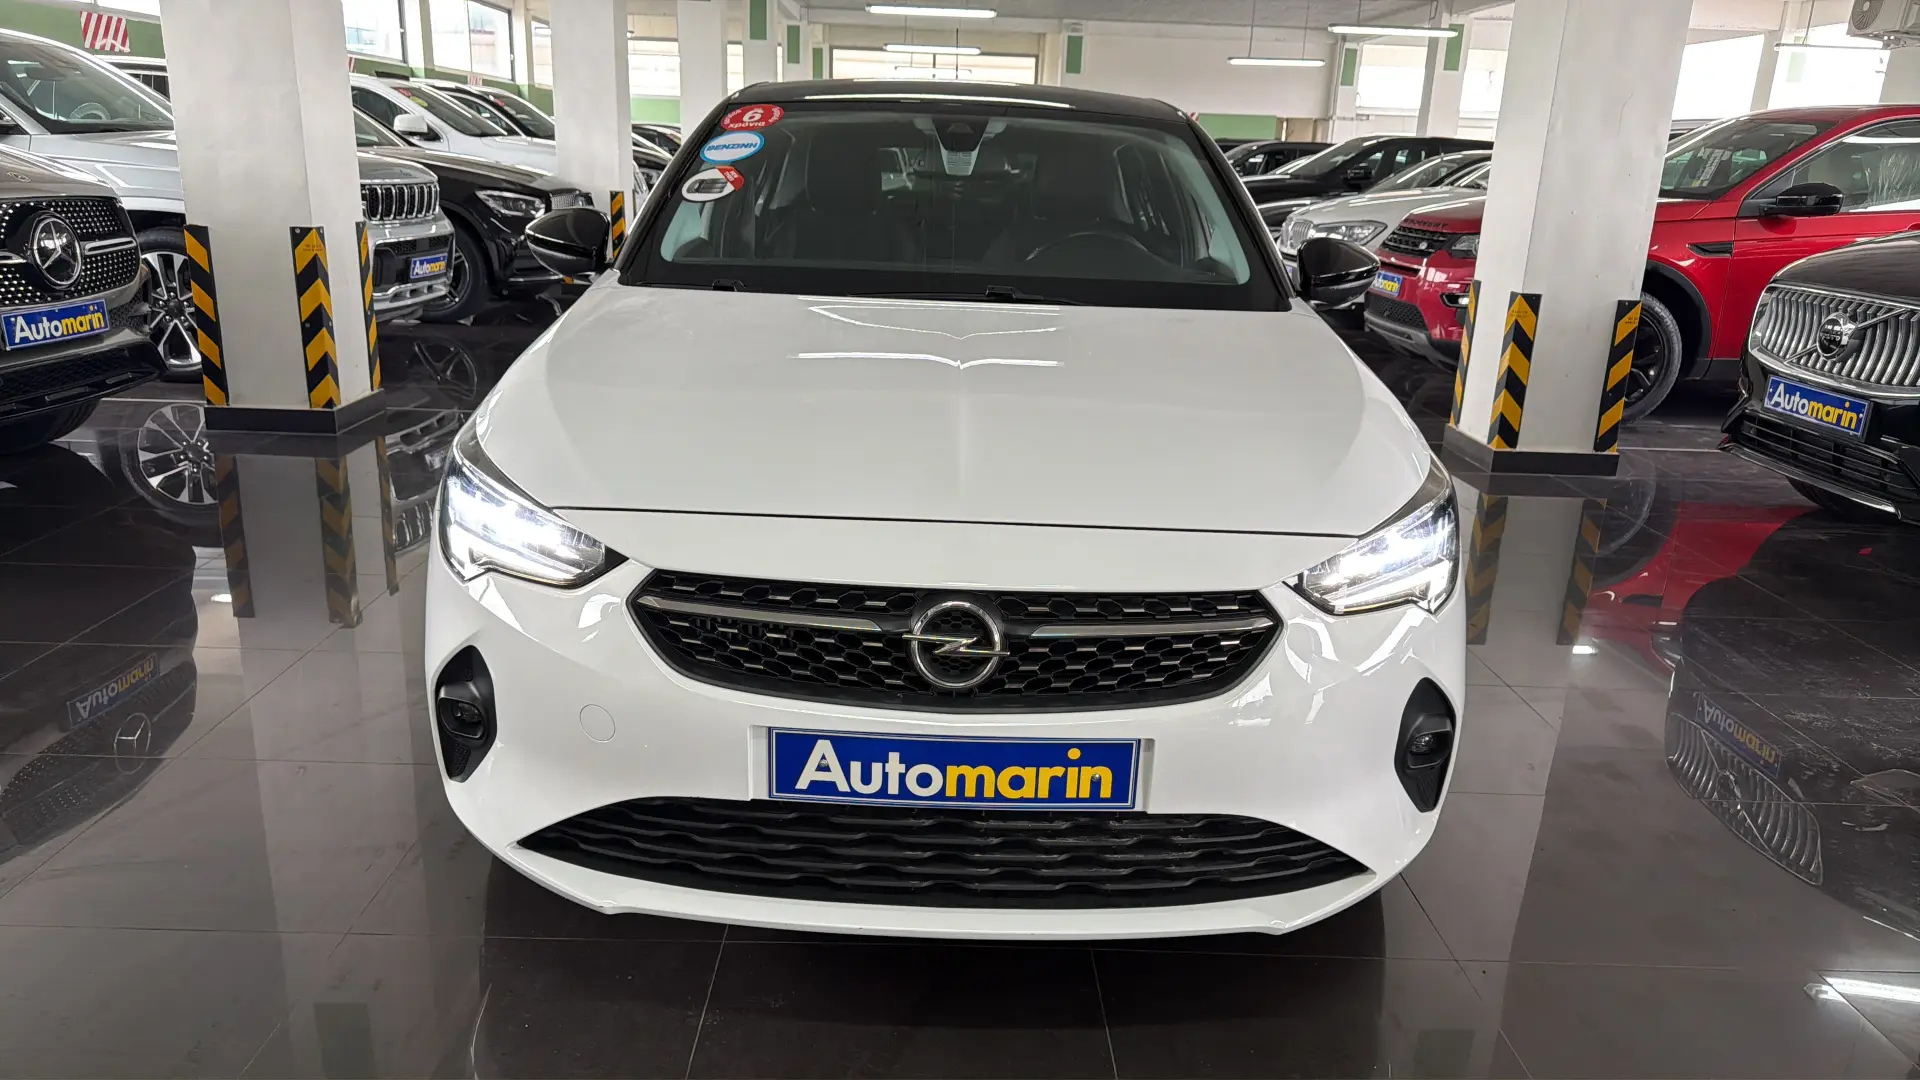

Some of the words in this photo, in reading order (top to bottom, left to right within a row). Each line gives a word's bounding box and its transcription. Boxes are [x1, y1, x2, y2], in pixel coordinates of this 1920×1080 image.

[742, 109, 764, 122] 6
[14, 304, 105, 344] Automarin
[1770, 383, 1859, 430] Automarin
[795, 739, 1113, 799] Automarin
